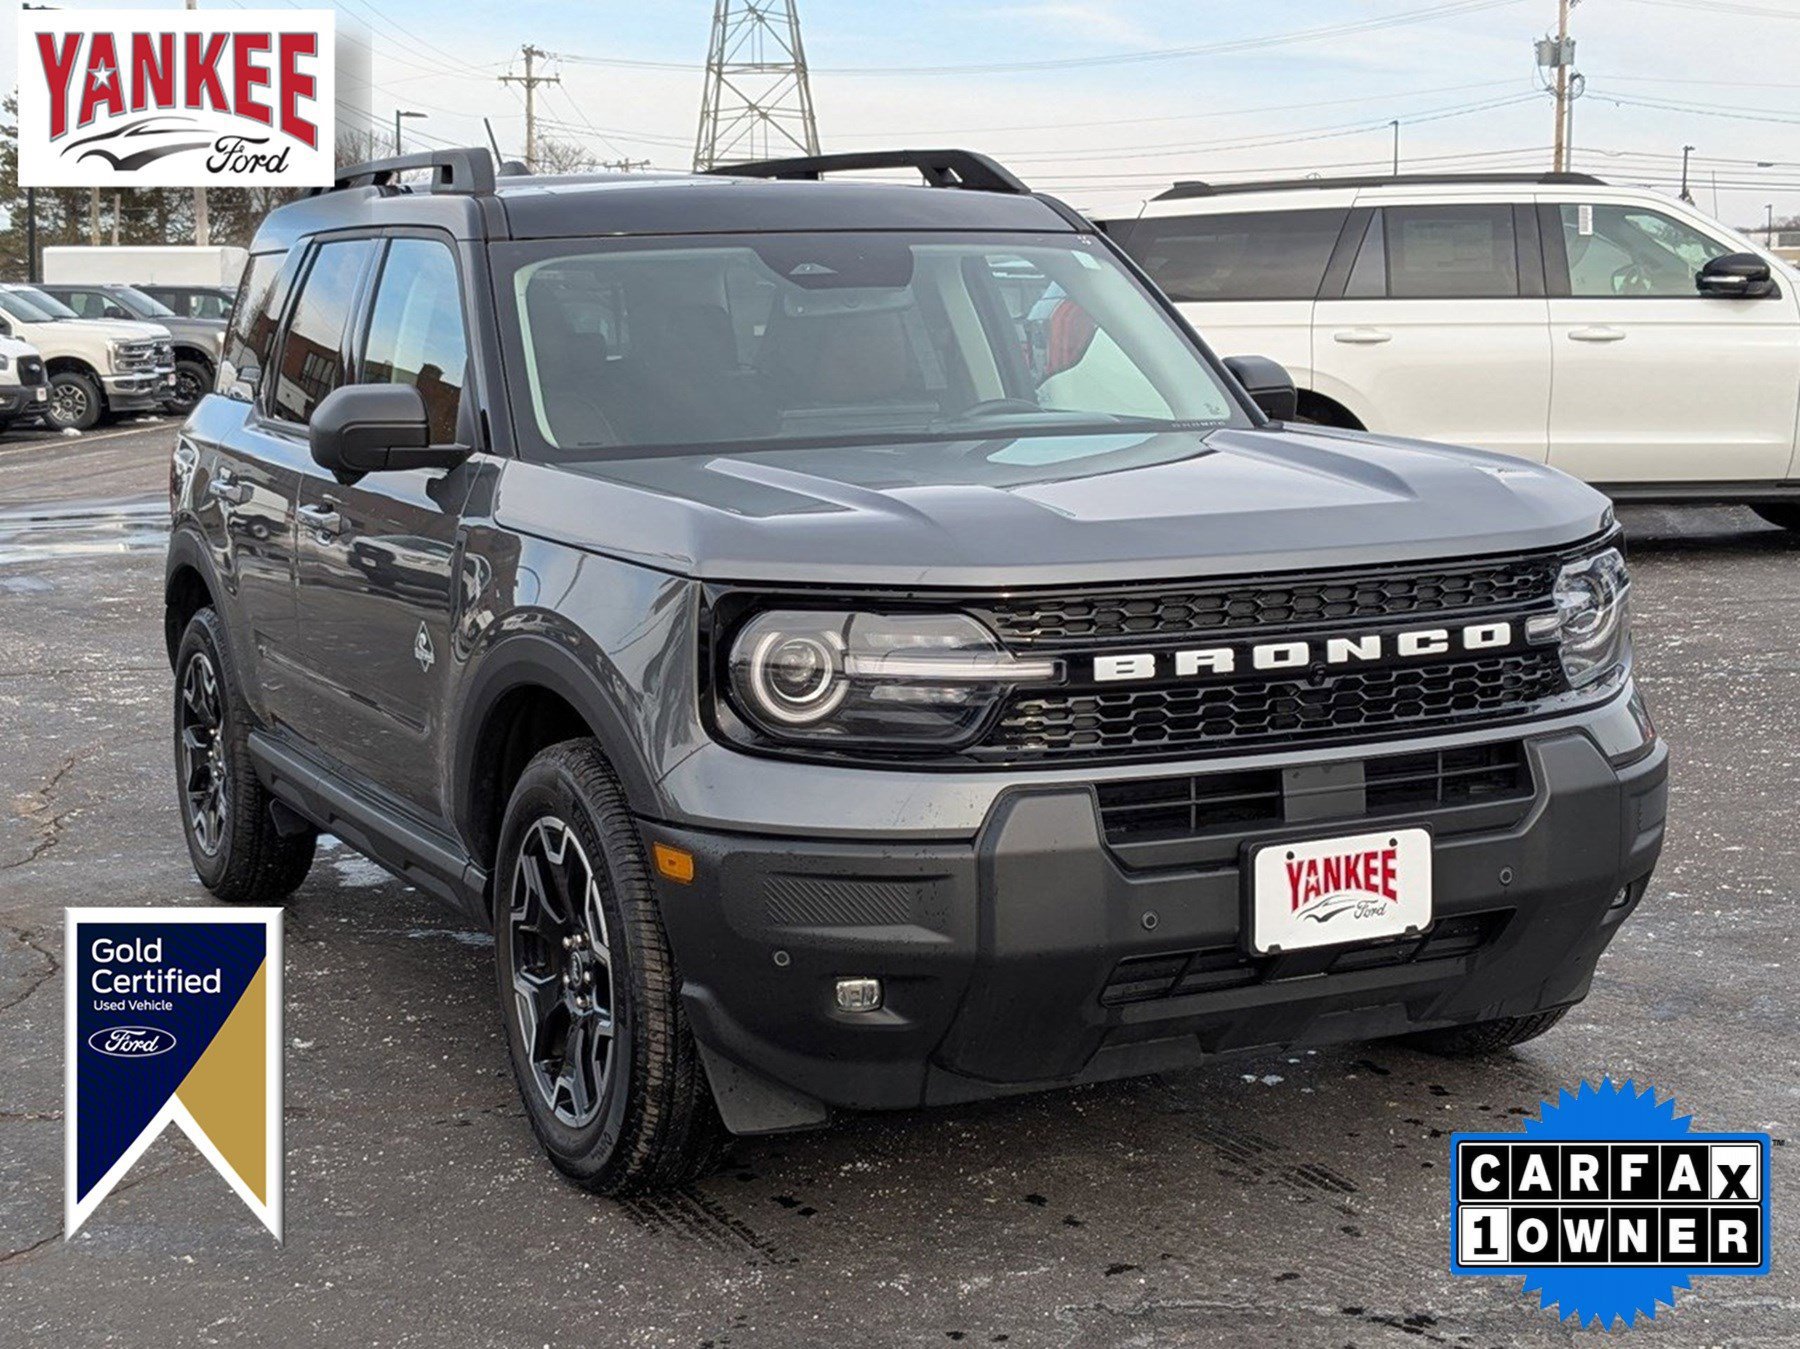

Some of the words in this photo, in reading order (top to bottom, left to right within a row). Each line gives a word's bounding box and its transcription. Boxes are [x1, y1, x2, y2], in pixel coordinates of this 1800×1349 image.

[1093, 622, 1511, 682] BRONCO
[1286, 849, 1397, 912] YANKEE
[1354, 900, 1387, 919] Ford
